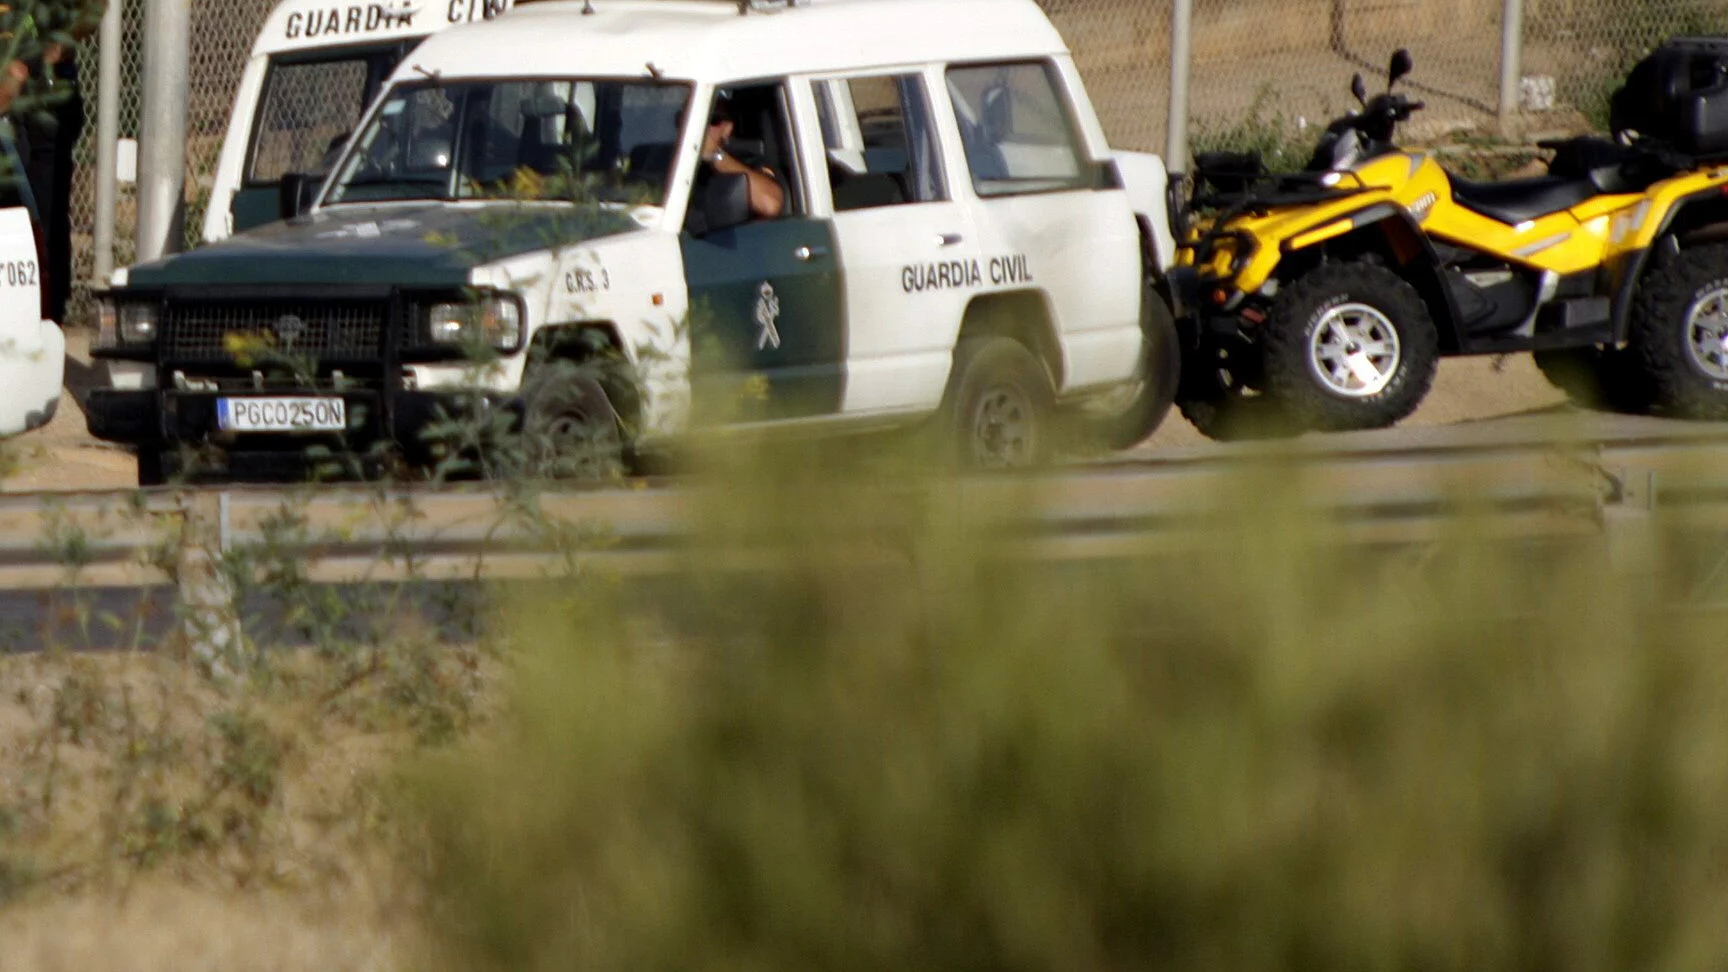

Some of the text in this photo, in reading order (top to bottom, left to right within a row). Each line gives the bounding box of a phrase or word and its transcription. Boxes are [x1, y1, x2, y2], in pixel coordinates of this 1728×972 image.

[7, 259, 37, 287] 062
[901, 254, 1033, 293] GUARDIA CIVIL
